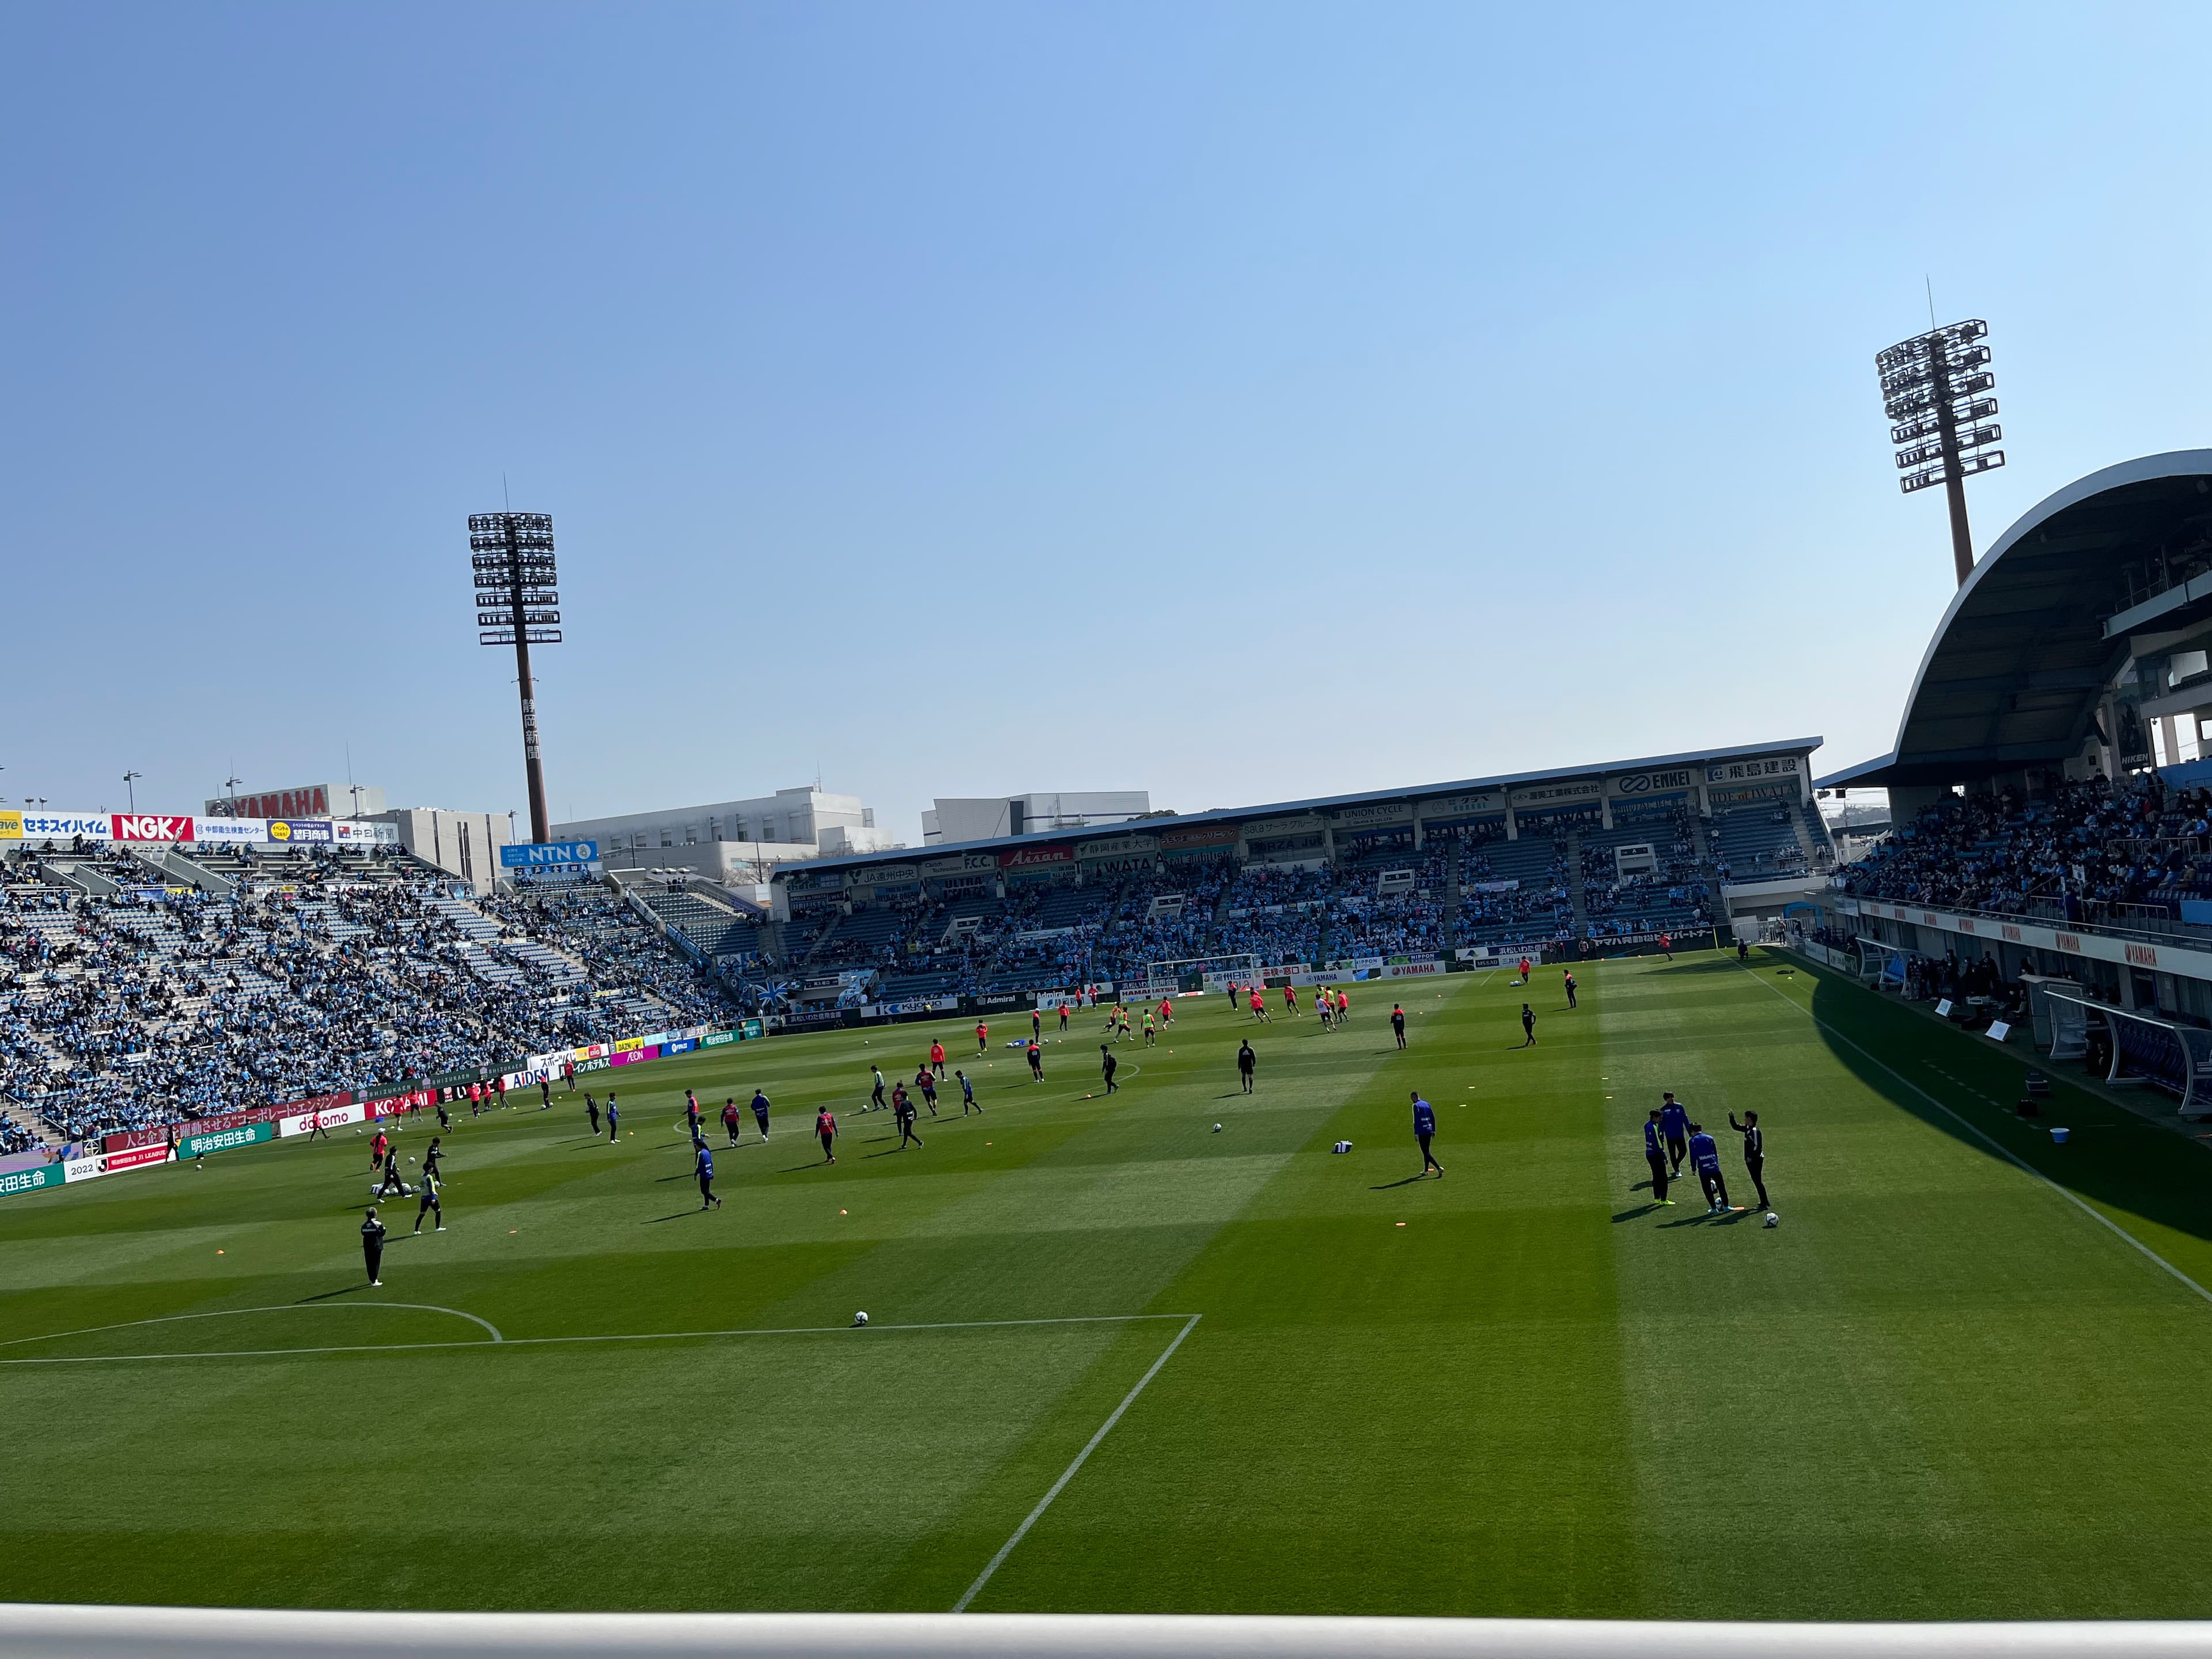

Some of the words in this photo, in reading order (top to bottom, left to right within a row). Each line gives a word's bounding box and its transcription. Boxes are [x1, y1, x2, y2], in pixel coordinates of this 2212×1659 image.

[1729, 759, 1797, 778] 飛島建設
[1652, 771, 1690, 789] ENKEI
[233, 787, 326, 817] YAMAHA
[1344, 809, 1374, 818] UNION
[1377, 805, 1403, 815] CYCLE
[23, 818, 107, 834] セキスイハイム
[121, 816, 174, 840] NGK
[206, 825, 264, 835] 中部衛生検査センター
[1266, 818, 1321, 832] サーラグループ
[353, 827, 394, 840] 中日新聞
[1202, 829, 1236, 840] クリニック
[1090, 838, 1153, 854] 静岡産業大学
[529, 845, 571, 862] NTN
[1003, 850, 1070, 866] Aisan
[933, 865, 962, 873] Technology
[964, 856, 990, 869] F.C.C.
[864, 869, 915, 883] JA遠州中央
[2061, 932, 2081, 952] YAMAHA
[1502, 956, 1540, 964] 三井住海上
[2131, 945, 2157, 967] YAMAHA
[1401, 964, 1435, 975] YAMAHA
[1213, 971, 1251, 982] 遠州日石
[1313, 974, 1338, 982] YAMAHA
[987, 995, 1016, 1004] Admiral
[1036, 990, 1066, 999] Admiral
[790, 1011, 842, 1023] 浜松いわた信用金庫
[432, 1073, 470, 1085] SHIZUKAEN
[369, 1084, 411, 1097] SHIZUKAEN
[375, 1092, 428, 1116] KOAMI
[299, 1112, 349, 1131] doomo
[191, 1127, 256, 1153] 明治安田生命
[145, 1149, 166, 1160] LEAGUE
[71, 1164, 93, 1176] 2022
